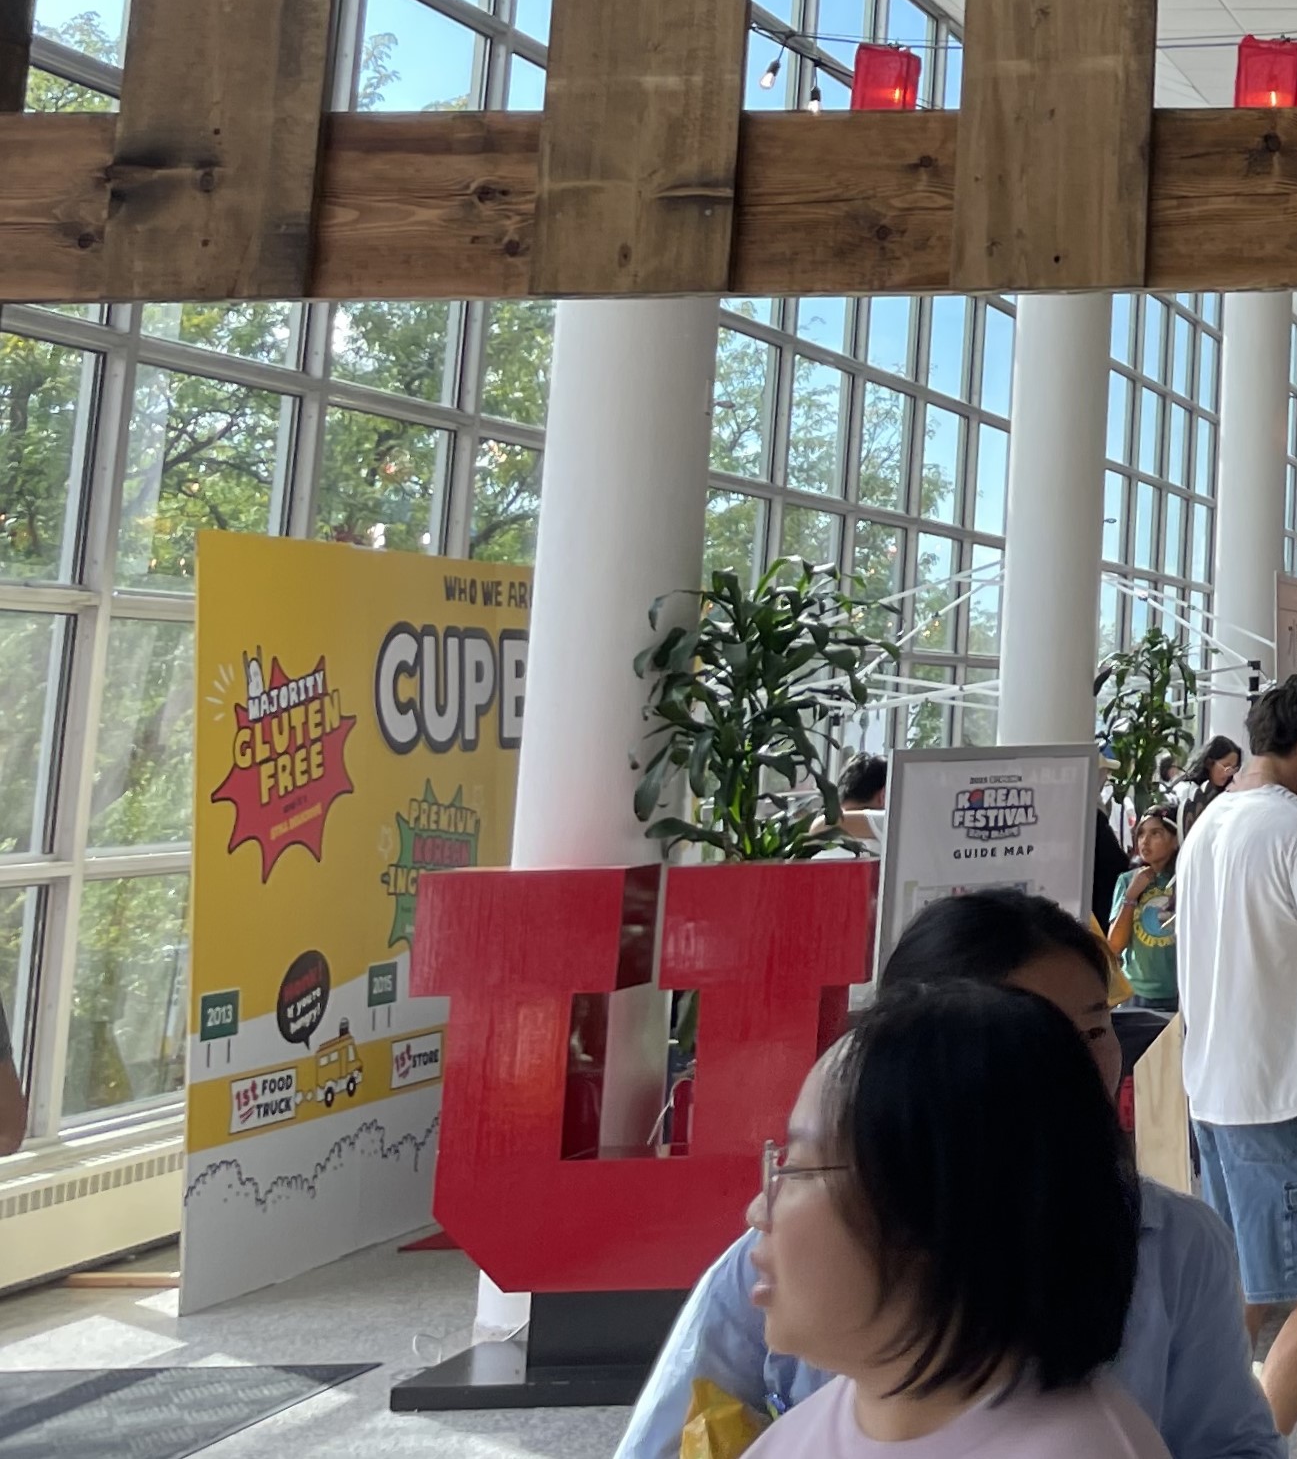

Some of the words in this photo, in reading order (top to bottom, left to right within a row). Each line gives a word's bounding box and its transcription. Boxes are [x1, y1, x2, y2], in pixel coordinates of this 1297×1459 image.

[444, 576, 478, 605] WHO
[481, 580, 503, 607] WE
[508, 581, 533, 609] AR
[248, 670, 326, 721] MAJORITY
[234, 690, 341, 769] GLUTEN
[260, 740, 325, 805] FREE
[957, 788, 1033, 809] KOREAN
[408, 798, 480, 834] PREMIUM
[953, 806, 1037, 828] FESTIVAL
[953, 847, 997, 859] GUIDE
[1004, 845, 1035, 857] MAP
[387, 864, 426, 896] ING
[372, 975, 393, 995] 2015
[206, 1004, 233, 1027] 2013
[394, 1043, 413, 1072] 1st
[411, 1047, 440, 1067] STORE
[235, 1079, 259, 1112] 1st
[261, 1073, 293, 1096] FOOD
[256, 1098, 293, 1120] TRUCK
